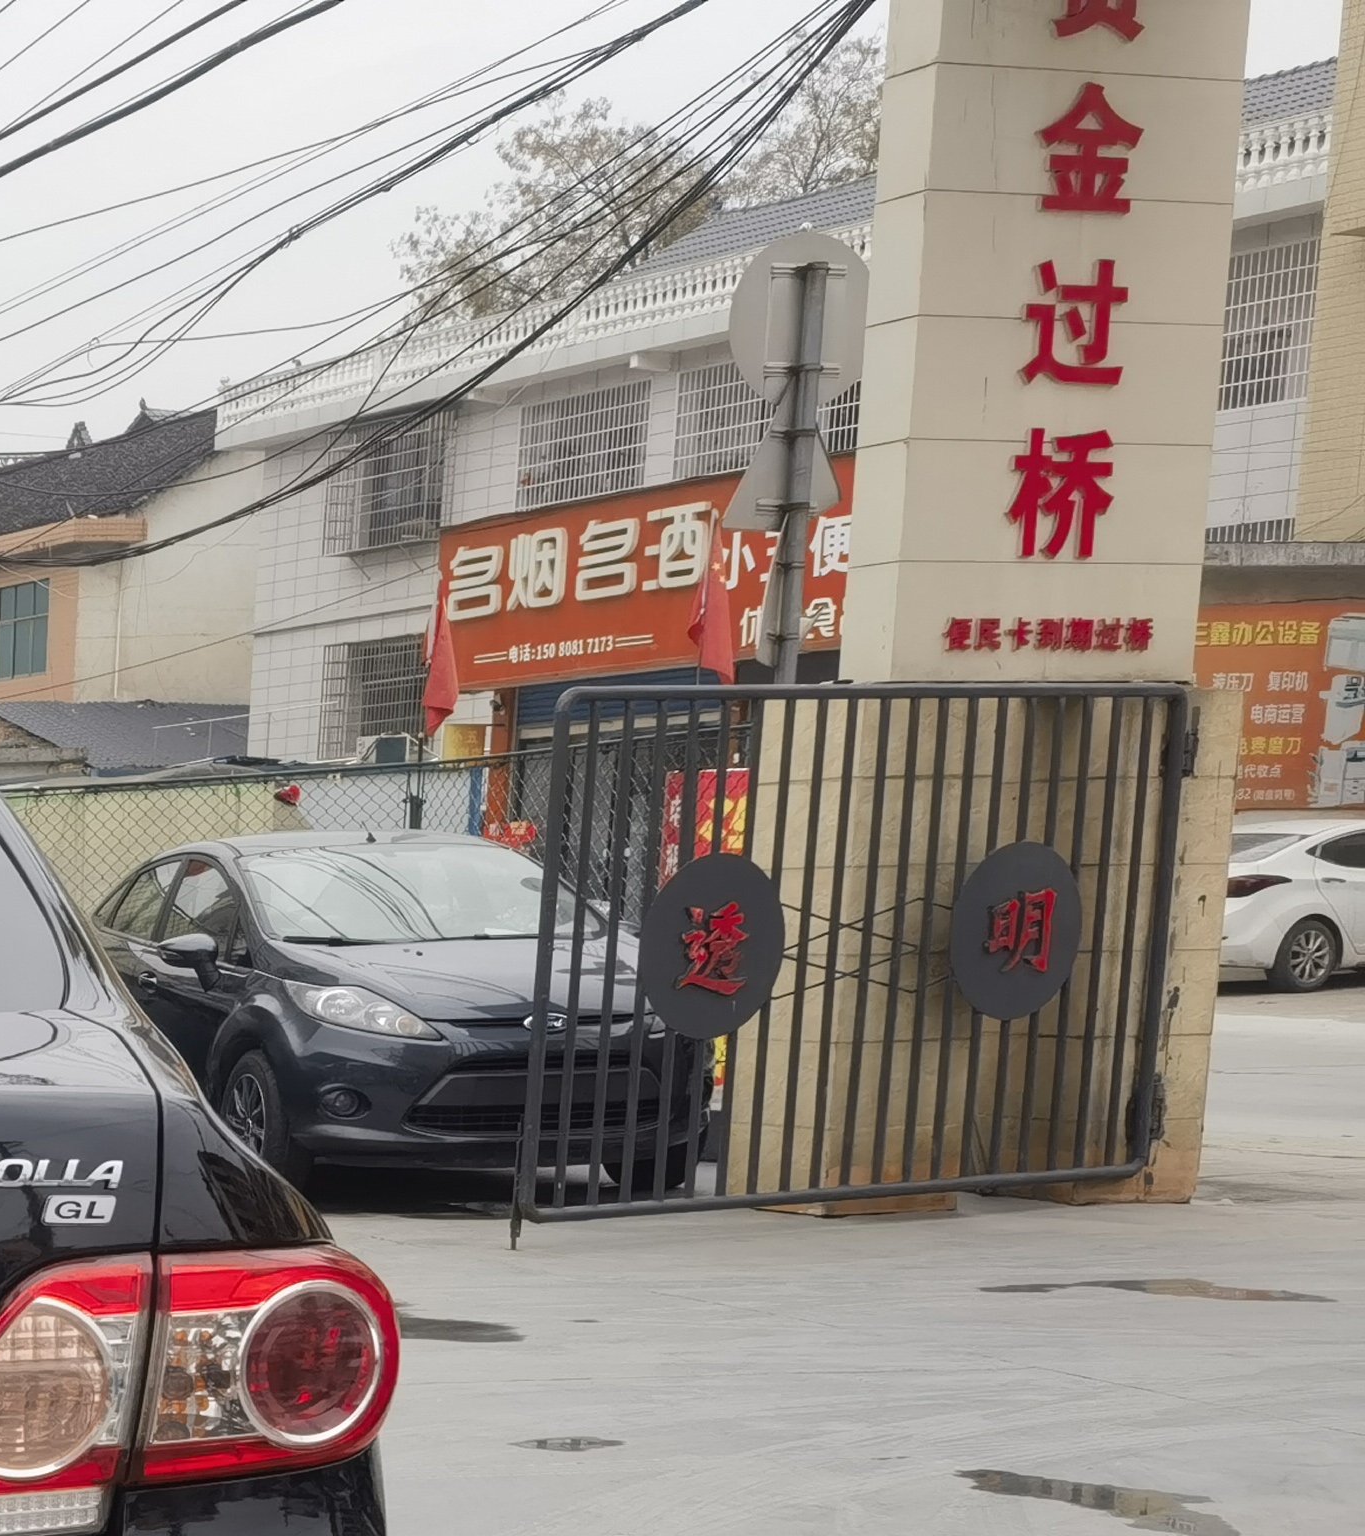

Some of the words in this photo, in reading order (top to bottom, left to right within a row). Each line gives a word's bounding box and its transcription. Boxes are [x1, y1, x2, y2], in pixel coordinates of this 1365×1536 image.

[447, 501, 712, 621] 名烟名酒
[943, 617, 1154, 653] 便民卡到期过桥
[558, 641, 584, 658] 8081
[586, 635, 614, 655] 7173
[1267, 671, 1309, 691] 复印机
[1250, 704, 1305, 724] 电商运营
[1238, 764, 1282, 779] 代收点
[983, 887, 1058, 974] 明
[54, 1200, 106, 1220] GL
